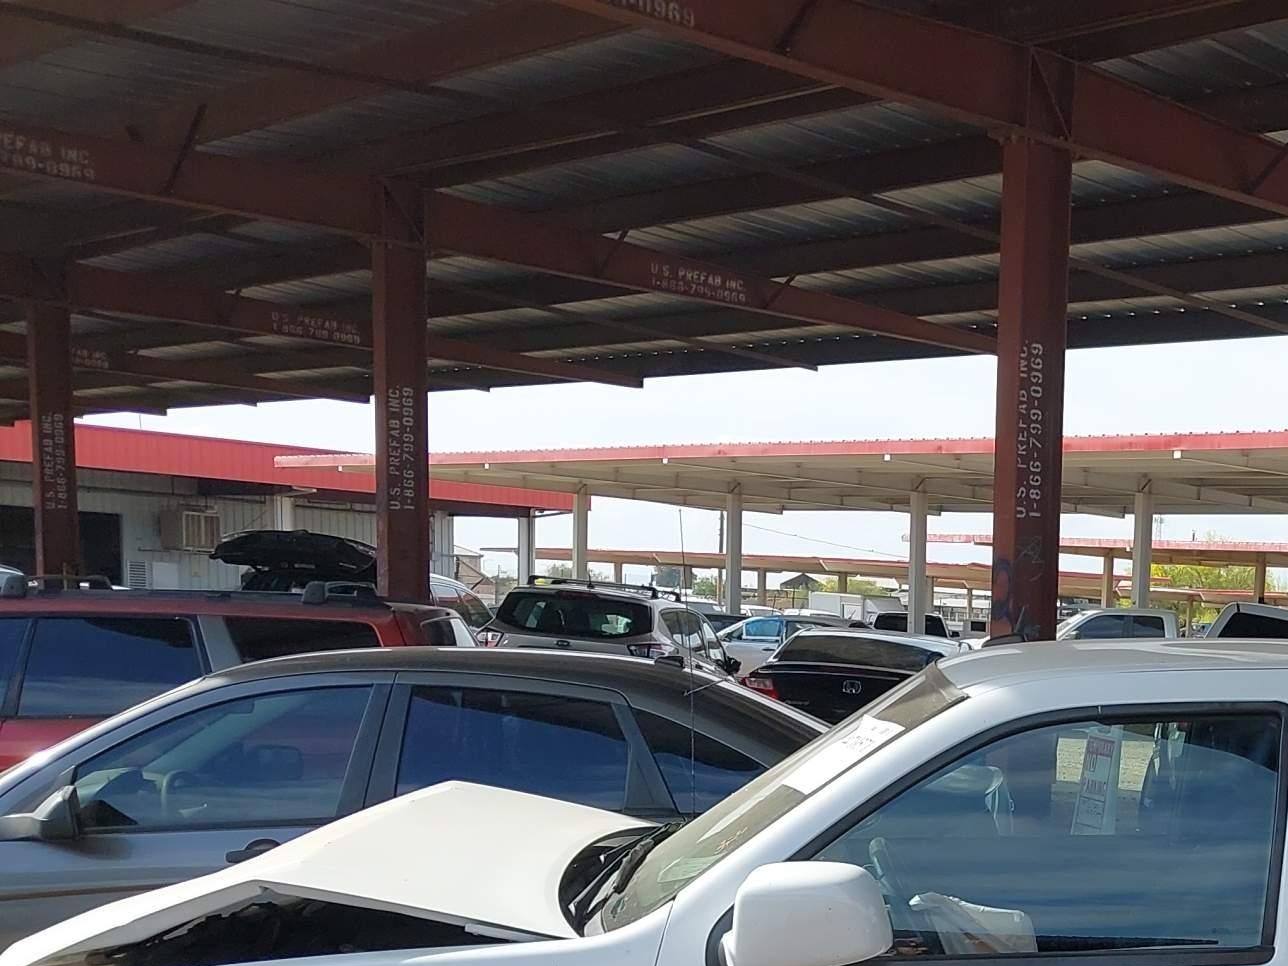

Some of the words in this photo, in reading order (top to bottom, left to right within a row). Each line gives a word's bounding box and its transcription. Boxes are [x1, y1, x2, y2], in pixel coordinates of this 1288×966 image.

[0, 132, 52, 158] EFAB
[678, 266, 722, 286] PREFAB
[388, 384, 400, 411] INC.
[389, 420, 401, 475] PREFAB
[1029, 343, 1043, 517] 1-866-799-0969
[43, 438, 54, 482] PREFAB
[402, 387, 415, 510] 1-866-799-0969
[389, 483, 402, 510] U.S.
